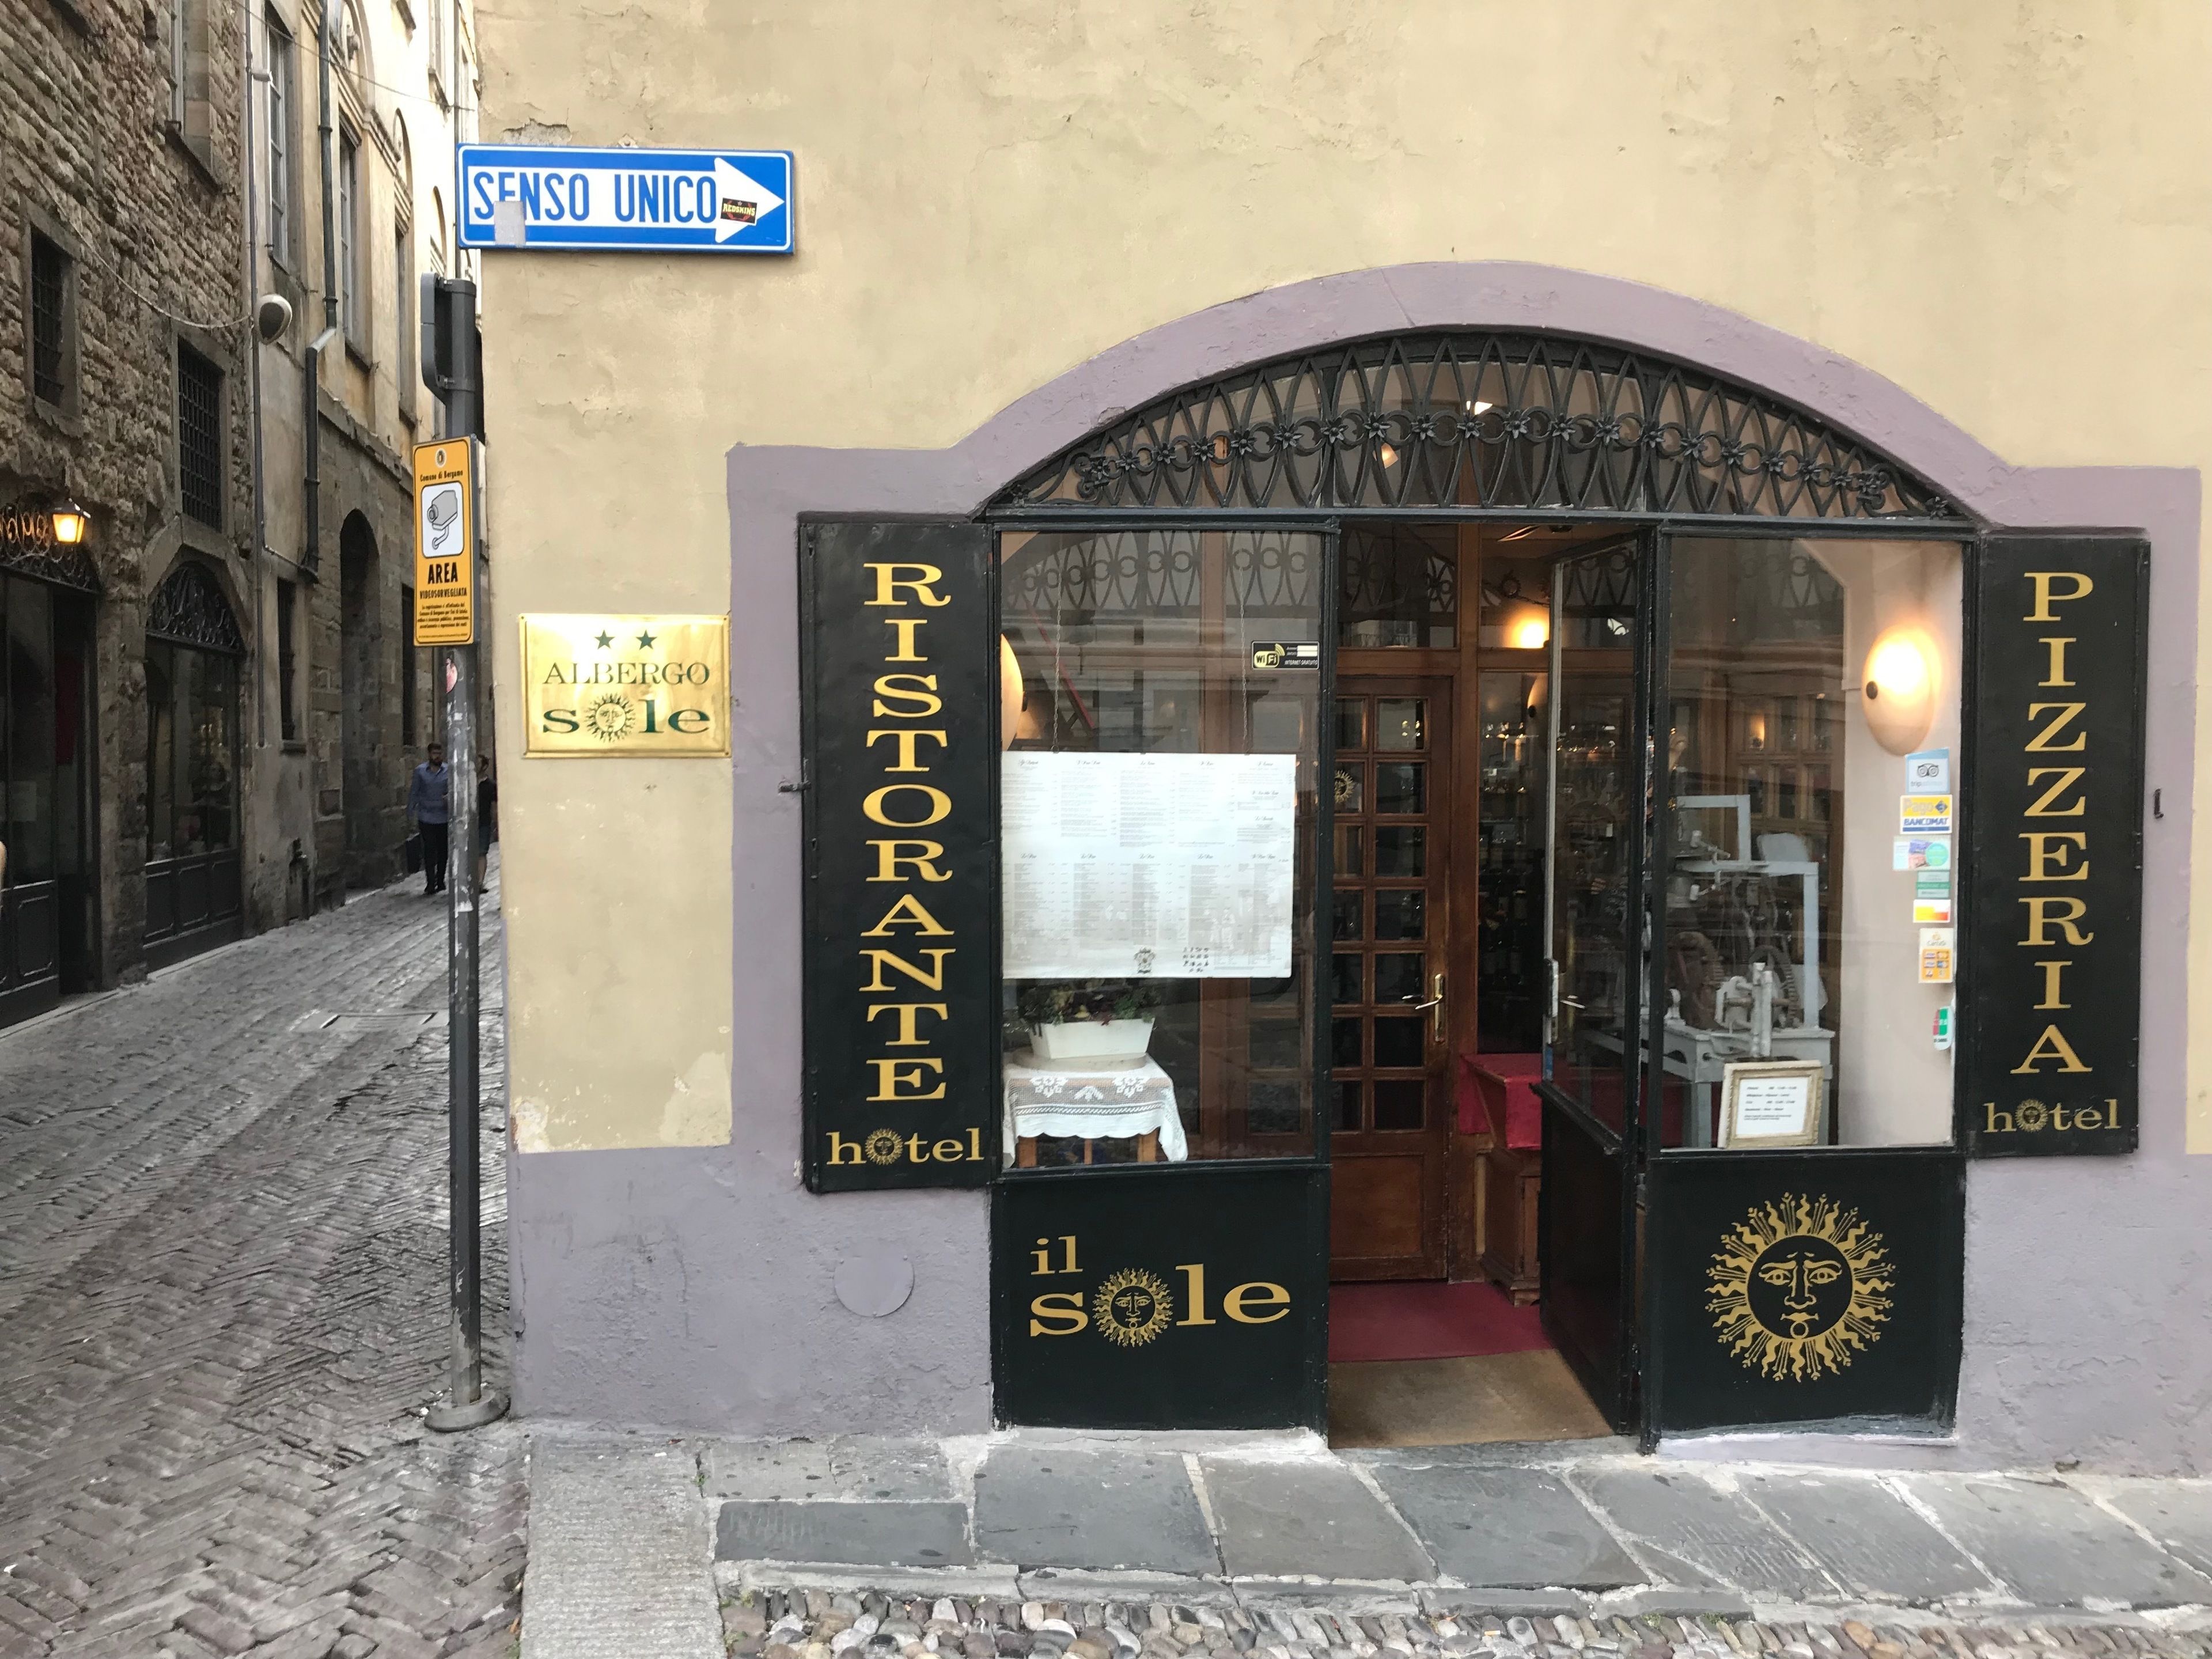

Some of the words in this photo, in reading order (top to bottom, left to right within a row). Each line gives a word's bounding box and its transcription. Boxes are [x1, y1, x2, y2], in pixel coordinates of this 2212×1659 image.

[473, 171, 590, 222] SENSO
[614, 173, 717, 224] UNICO
[722, 203, 756, 217] REDSKINS
[438, 471, 442, 479] di
[444, 469, 463, 479] Bergamo
[427, 562, 459, 585] AREA
[420, 588, 467, 599] VIDEOSORVEGLIATA
[542, 662, 710, 685] ALBERGO
[858, 563, 956, 1101] RISTORANTE
[1904, 817, 1949, 826] BANCOMAT
[2009, 572, 2094, 1074] PIZZERIA
[1030, 1235, 1084, 1275] il
